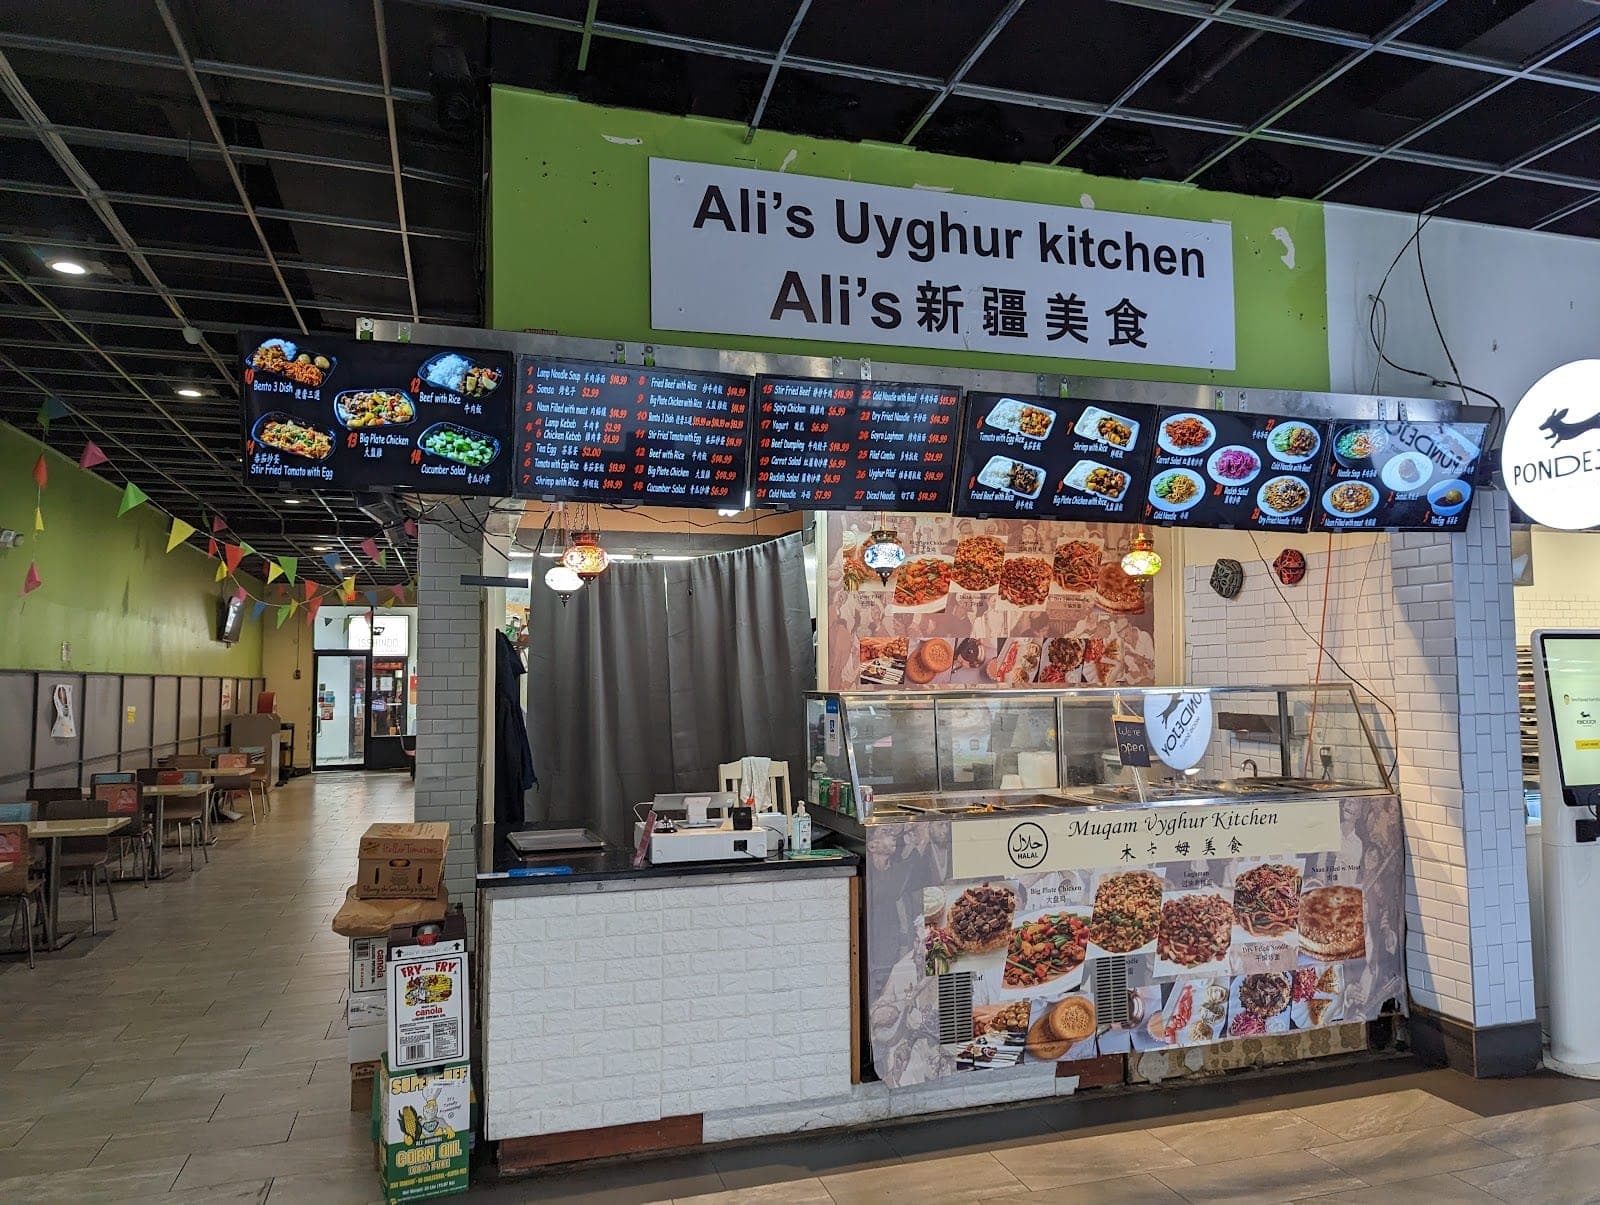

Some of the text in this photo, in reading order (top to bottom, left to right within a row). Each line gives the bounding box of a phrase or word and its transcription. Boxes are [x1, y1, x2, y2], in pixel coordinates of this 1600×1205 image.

[692, 184, 1206, 279] Ali's Uyghur kitchen
[769, 270, 1148, 349] Ali's 新疆美食
[551, 369, 581, 383] Noodle Soup
[254, 380, 293, 393] Bento 3 Dish
[527, 384, 533, 394] 2
[582, 387, 600, 398] $2.99
[651, 378, 697, 391] Fried Beef with Rice
[774, 385, 784, 395] Stir
[785, 385, 799, 396] Fried
[419, 391, 461, 405] Beef with Rice
[773, 402, 787, 415] Spicy
[787, 403, 806, 413] Chicken
[827, 405, 846, 416] $6.99
[604, 423, 621, 432] $2.99
[772, 419, 789, 432] Yogurt
[811, 422, 829, 432] $6.99
[359, 433, 409, 446] Big Plate Chicken
[543, 429, 564, 440] Chicken
[771, 438, 783, 448] Beef
[536, 443, 546, 454] Tea
[547, 443, 557, 456] Egg
[582, 447, 602, 457] $2.00
[649, 448, 661, 459] Beef
[662, 450, 673, 459] with
[674, 450, 685, 460] Rice
[534, 458, 551, 468] Tomato
[551, 459, 560, 469] with
[561, 459, 570, 472] Egg
[570, 461, 579, 470] Rice
[771, 456, 787, 465] Carrot
[787, 456, 802, 466] Salad
[828, 459, 846, 469] $6.99
[1513, 450, 1600, 486] PONDE
[251, 464, 333, 480] Stir Fried Tomato with Egg
[420, 463, 467, 476] Cucumber Salad
[647, 465, 656, 478] Big
[656, 466, 669, 477] Plate
[670, 467, 689, 477] Chicken
[535, 475, 554, 488] Shrimp
[555, 477, 567, 487] with
[567, 477, 579, 487] Rice
[786, 473, 800, 482] Salad
[647, 482, 672, 493] Cucumber
[672, 484, 686, 494] Salad
[710, 486, 729, 496] $6.99
[1068, 820, 1138, 840] Muqam
[1211, 808, 1279, 830] Kitchen
[1017, 852, 1039, 860] HALAL
[1058, 884, 1082, 892] Chicken
[376, 949, 384, 978] canola
[401, 962, 456, 977] FRY FRY
[415, 1007, 443, 1016] canola
[396, 1145, 435, 1168] CORN
[439, 1140, 462, 1159] OIL
